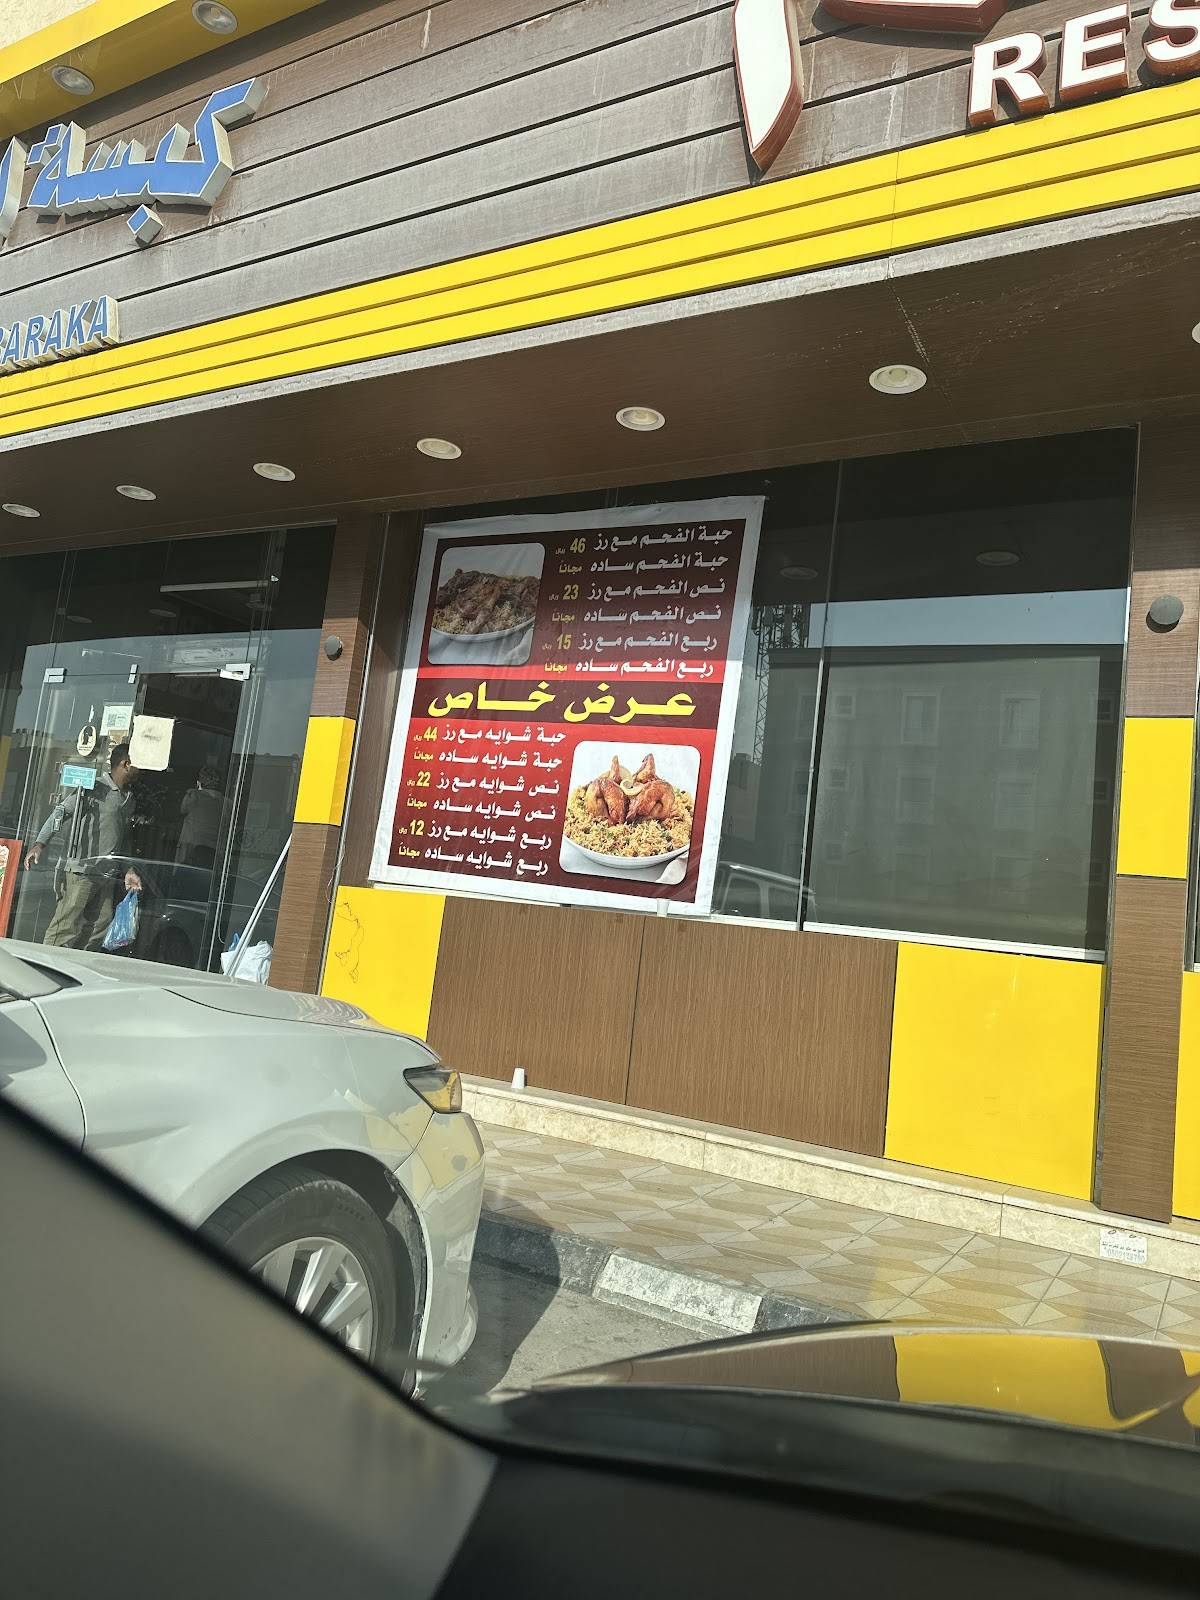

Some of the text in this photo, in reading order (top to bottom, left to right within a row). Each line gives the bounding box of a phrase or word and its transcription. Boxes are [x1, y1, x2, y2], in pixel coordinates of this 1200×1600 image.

[27, 77, 258, 237] كبسة
[0, 295, 111, 366] ARAKA
[594, 533, 609, 551] رز
[610, 534, 638, 552] مع
[639, 527, 695, 549] الفحم
[698, 525, 733, 545] حبة
[570, 537, 586, 554] 46
[636, 553, 691, 575] الفحم
[694, 551, 729, 571] حبة
[563, 584, 579, 600] 23
[587, 582, 602, 600] رز
[604, 584, 631, 602] مع
[633, 579, 688, 600] الفحم
[689, 577, 726, 598] نص
[629, 605, 684, 625] الفحم
[685, 604, 722, 625] نص
[556, 634, 572, 650] 15
[577, 632, 593, 650] رز
[596, 634, 622, 652] مع
[624, 631, 679, 651] الفحم
[680, 633, 717, 652] ربع
[620, 657, 675, 677] الفحم
[676, 660, 714, 679] ربع
[427, 680, 697, 724] عرض خاص
[423, 726, 438, 742] 44
[442, 724, 456, 741] رز
[458, 727, 482, 743] مع
[536, 726, 567, 747] حبة
[532, 751, 563, 772] حبة
[416, 771, 431, 787] 22
[436, 772, 450, 789] رز
[452, 775, 476, 792] مع
[528, 778, 560, 797] نص
[524, 804, 556, 822] نص
[409, 819, 425, 836] 12
[427, 819, 442, 838] رز
[443, 826, 468, 841] مع
[519, 831, 552, 851] ربع
[516, 857, 548, 876] ربع
